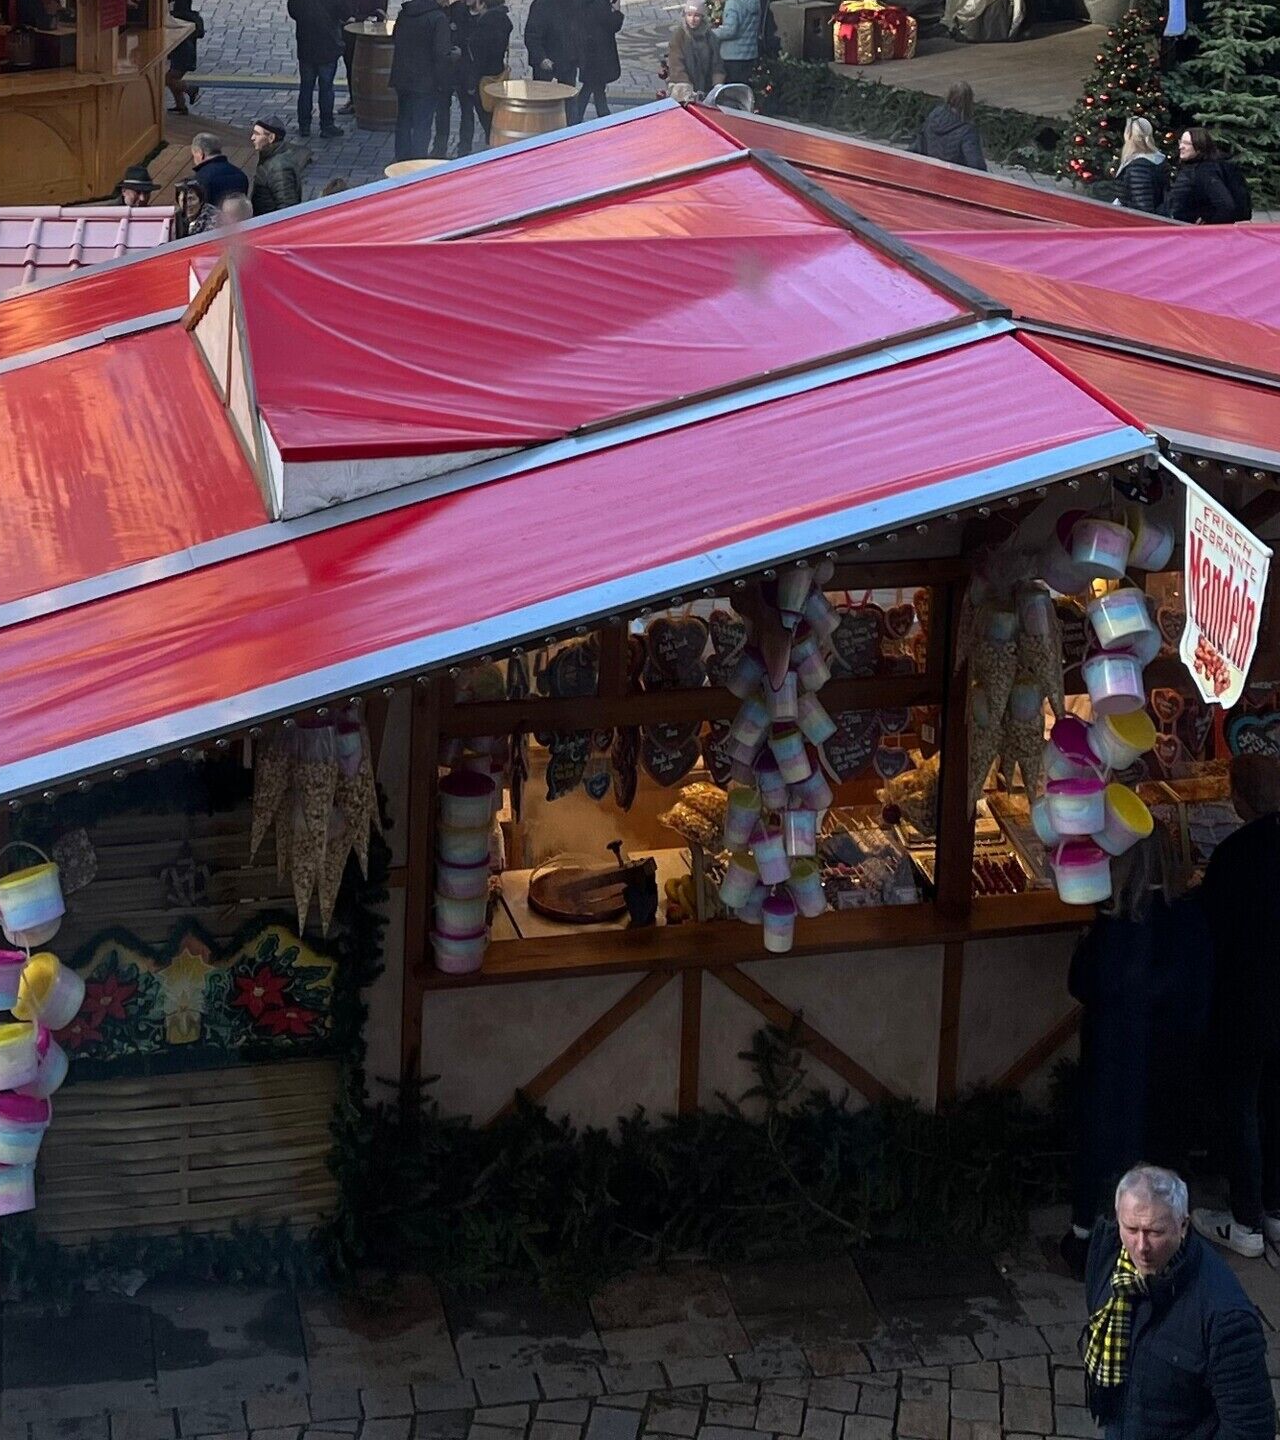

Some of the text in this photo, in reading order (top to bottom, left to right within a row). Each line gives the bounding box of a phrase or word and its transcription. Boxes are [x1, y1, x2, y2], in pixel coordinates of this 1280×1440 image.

[1194, 516, 1257, 583] GEBRANNTE
[1203, 505, 1253, 555] FRISCH
[1189, 530, 1256, 672] Mandeln
